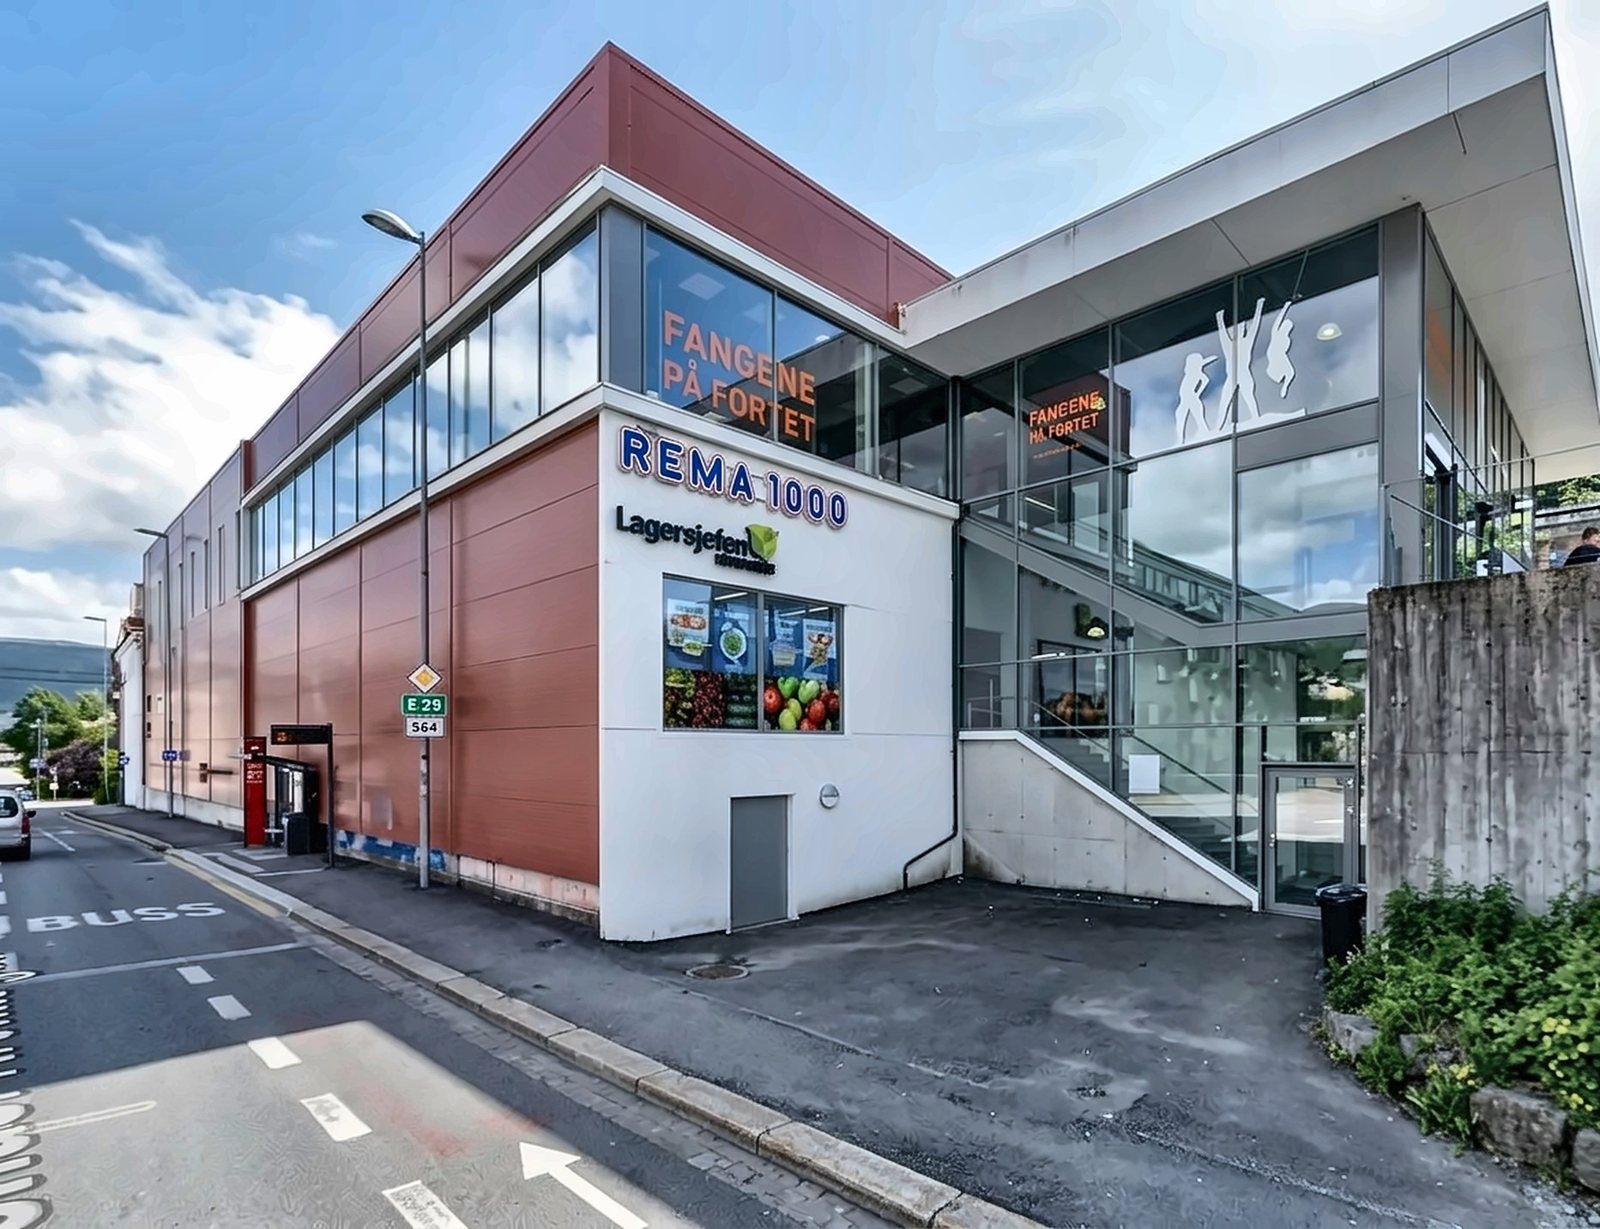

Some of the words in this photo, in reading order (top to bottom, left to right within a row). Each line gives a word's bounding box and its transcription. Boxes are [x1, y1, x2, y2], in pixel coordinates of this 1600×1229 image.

[664, 310, 816, 406] FANGENE
[664, 358, 704, 401] PÅ
[1048, 412, 1099, 439] FORTET
[620, 424, 754, 505] REMA
[766, 470, 848, 529] 1000
[615, 504, 748, 558] Lagersjefen
[407, 698, 417, 712] E
[411, 721, 437, 733] 564
[27, 902, 225, 933] BUSS
